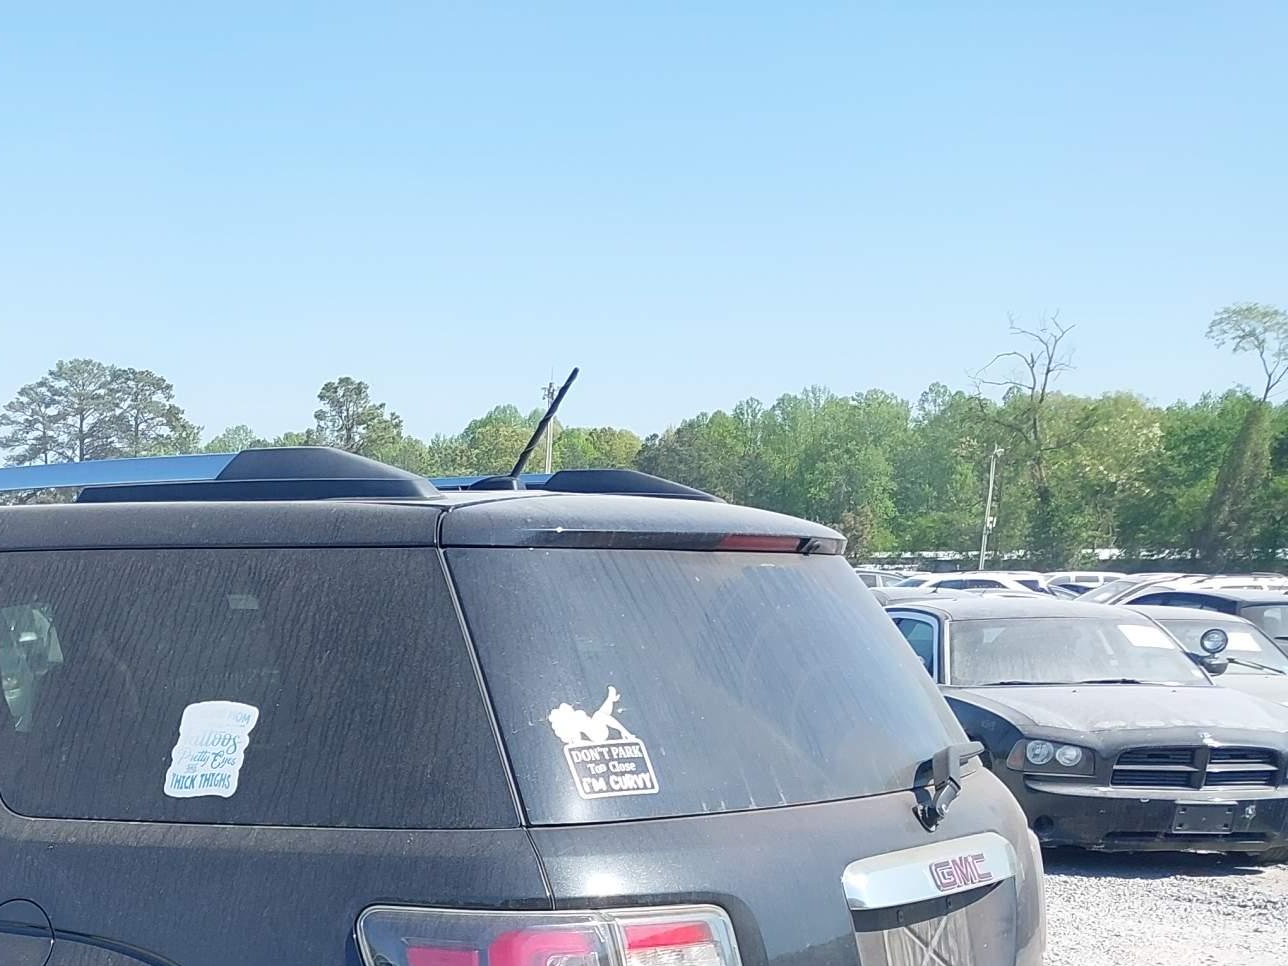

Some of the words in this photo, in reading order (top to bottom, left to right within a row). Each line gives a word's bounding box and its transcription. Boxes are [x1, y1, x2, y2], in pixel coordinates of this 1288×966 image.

[184, 730, 242, 756] attoos
[210, 751, 237, 769] Eyes
[571, 747, 610, 763] DON'T
[611, 745, 643, 759] PARK
[587, 762, 607, 775] Too
[609, 760, 636, 773] Close
[170, 773, 197, 790] THICK
[199, 772, 231, 790] THIGHS
[610, 773, 652, 790] CURVY
[929, 853, 993, 892] GMC
